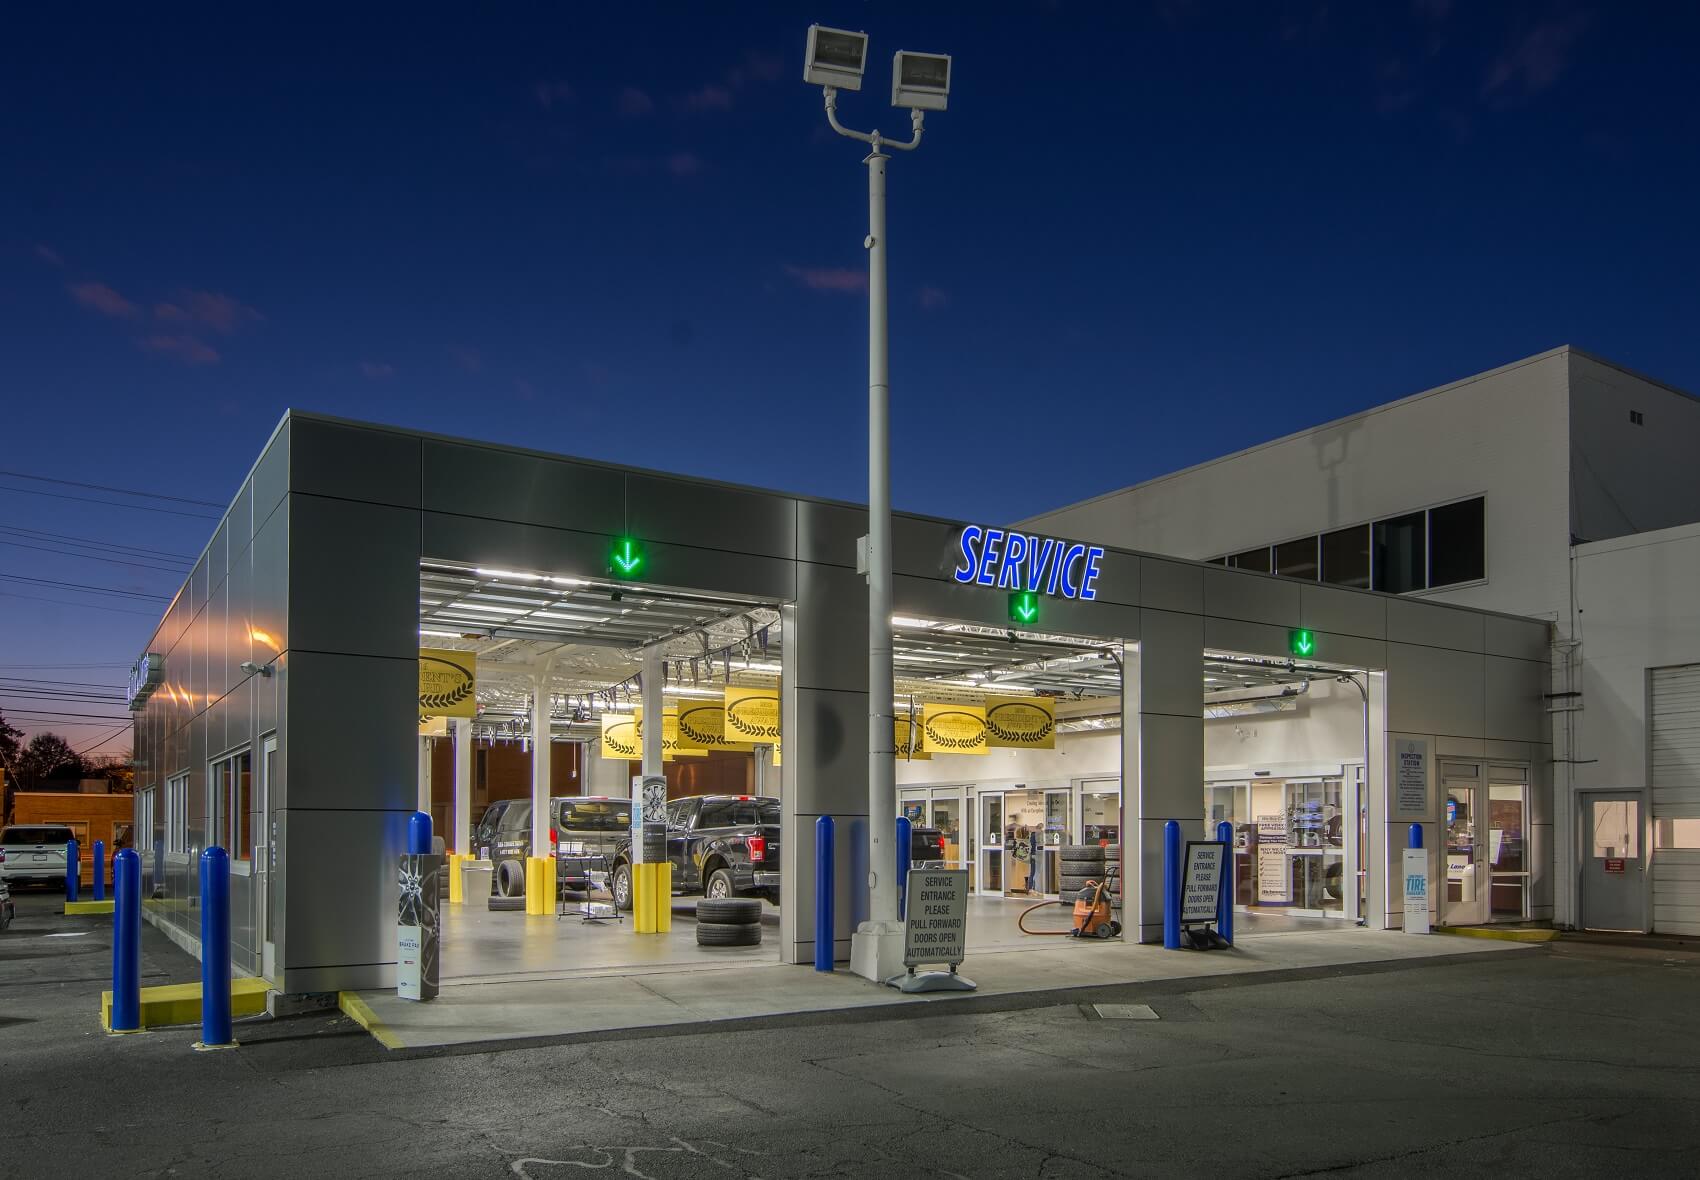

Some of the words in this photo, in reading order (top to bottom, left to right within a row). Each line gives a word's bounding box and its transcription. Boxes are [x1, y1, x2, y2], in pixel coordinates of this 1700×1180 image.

[954, 525, 1104, 601] SERVICE
[1196, 851, 1215, 860] SERVICE
[1194, 862, 1216, 871] ENTRANCE
[925, 876, 952, 887] SERVICE
[1195, 873, 1212, 881] PLEASE
[1186, 884, 1197, 893] PULL
[1197, 884, 1217, 892] FORWARD
[1406, 878, 1426, 891] TIRE
[920, 891, 956, 901] ENTRANCE
[1188, 895, 1203, 904] DOORS
[1203, 895, 1214, 903] OPEN
[924, 905, 950, 915] PLEASE
[1183, 905, 1216, 914] AUTOMATICALLY
[910, 920, 927, 929] PULL
[928, 919, 961, 929] FORWARD
[914, 933, 937, 943] DOORS
[938, 932, 956, 942] OPEN
[906, 946, 962, 957] AUTOMATICALLY
